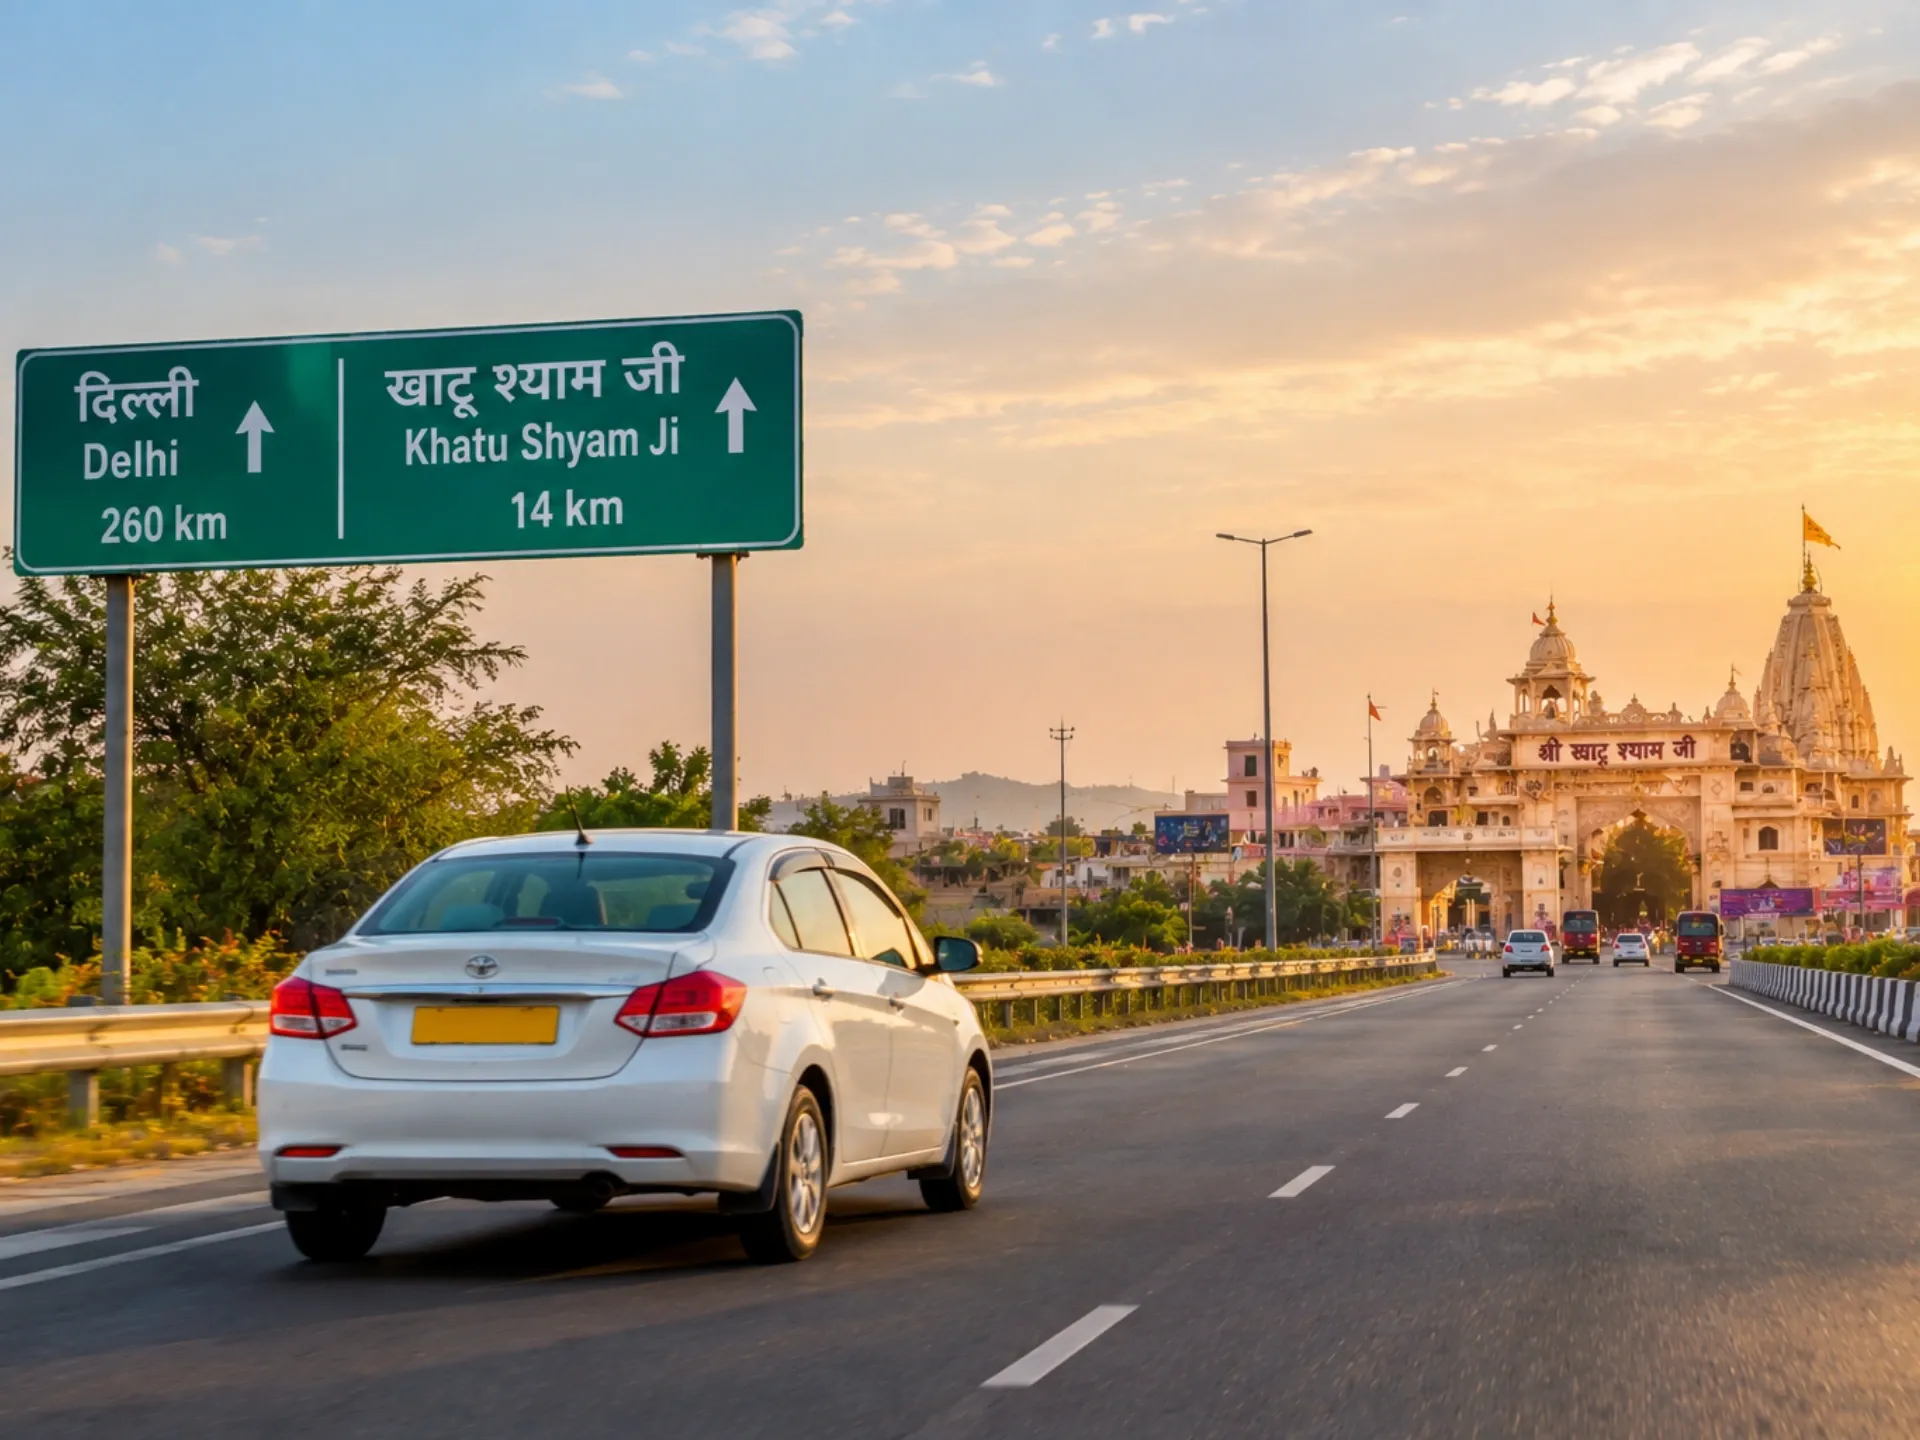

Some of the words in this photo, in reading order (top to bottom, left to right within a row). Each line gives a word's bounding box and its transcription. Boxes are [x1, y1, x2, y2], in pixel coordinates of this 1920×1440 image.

[75, 366, 199, 423] दिल्ली
[385, 367, 479, 419] खाटू
[493, 360, 606, 402] श्याम
[622, 341, 685, 395] जी
[84, 440, 177, 480] Delhi
[405, 427, 508, 466] Khatu
[521, 421, 639, 468] Shyam
[650, 416, 678, 456] Ji
[101, 505, 163, 544] 260
[175, 505, 227, 541] km
[511, 490, 553, 529] 14
[566, 489, 623, 527] km
[1538, 735, 1563, 762] श्री
[1617, 742, 1665, 761] श्याम
[1672, 734, 1697, 759] जी
